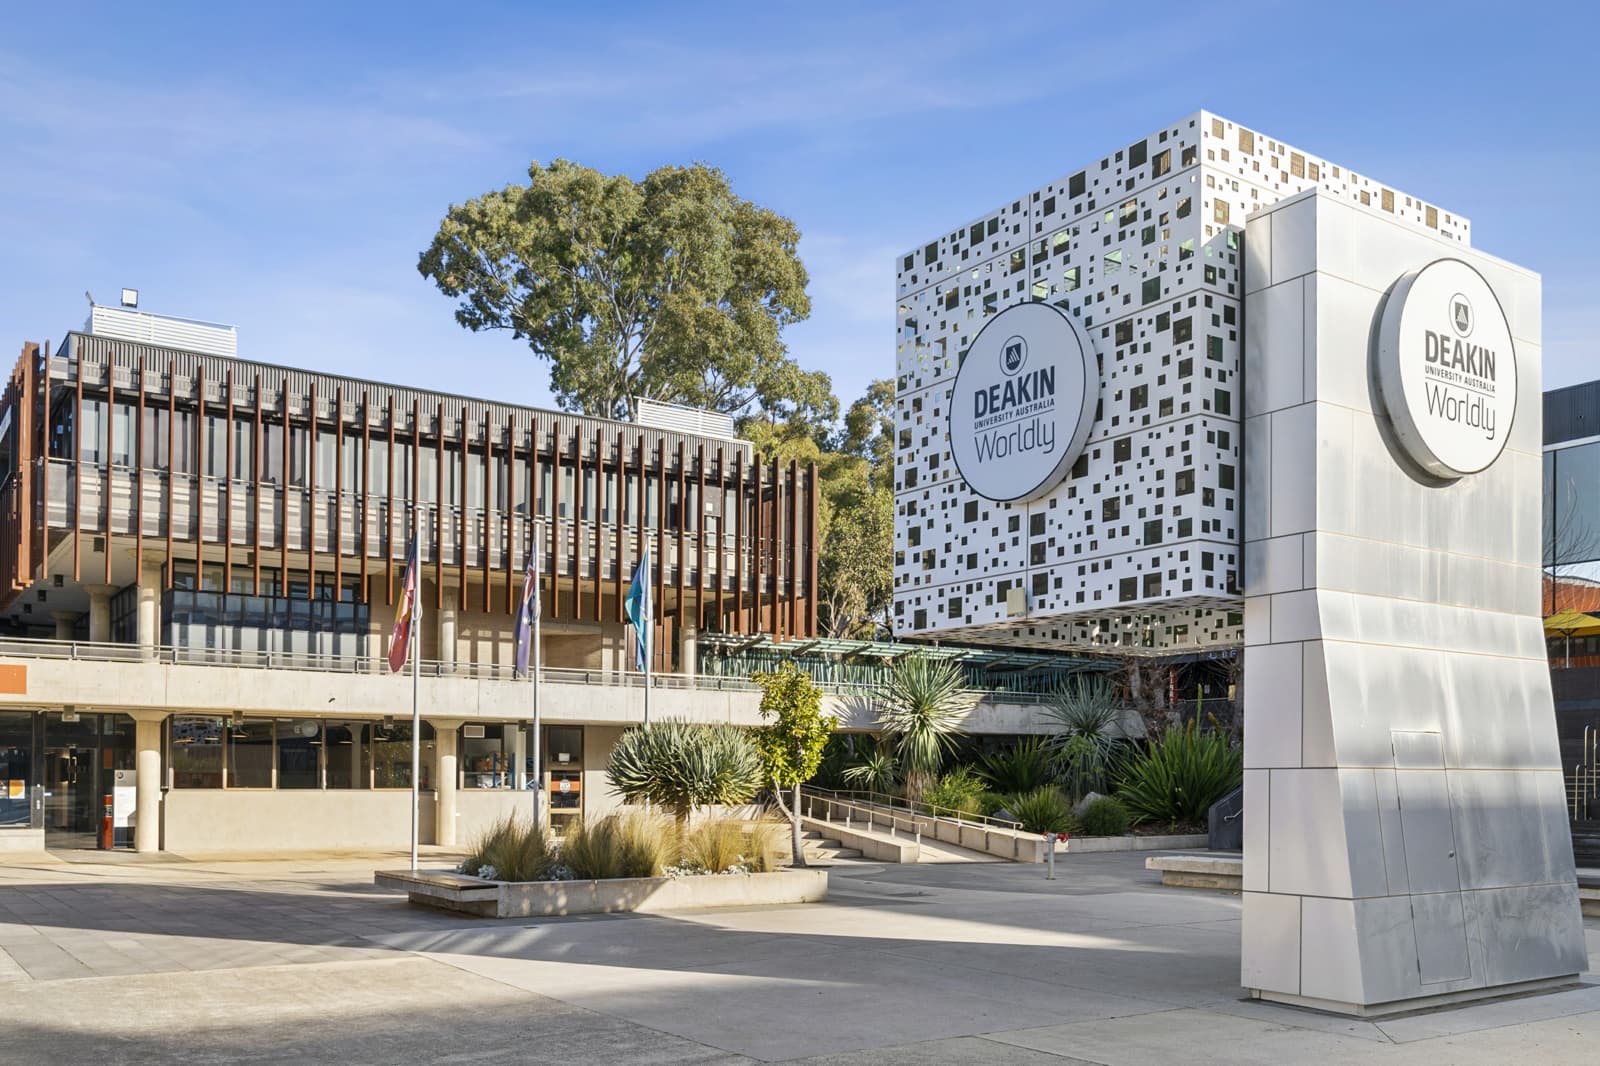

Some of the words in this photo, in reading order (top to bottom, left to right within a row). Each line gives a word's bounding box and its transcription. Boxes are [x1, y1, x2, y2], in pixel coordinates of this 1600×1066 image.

[1425, 329, 1495, 381] DEAKIN
[1425, 364, 1463, 381] UNIVERSITY
[1464, 376, 1495, 392] AUSTRALIA
[974, 365, 1055, 419] DEAKIN
[974, 411, 1013, 429] UNIVERSITY
[1015, 398, 1055, 416] AUSTRALIA
[1425, 381, 1495, 440] Worldly
[974, 418, 1055, 464] Worldly
